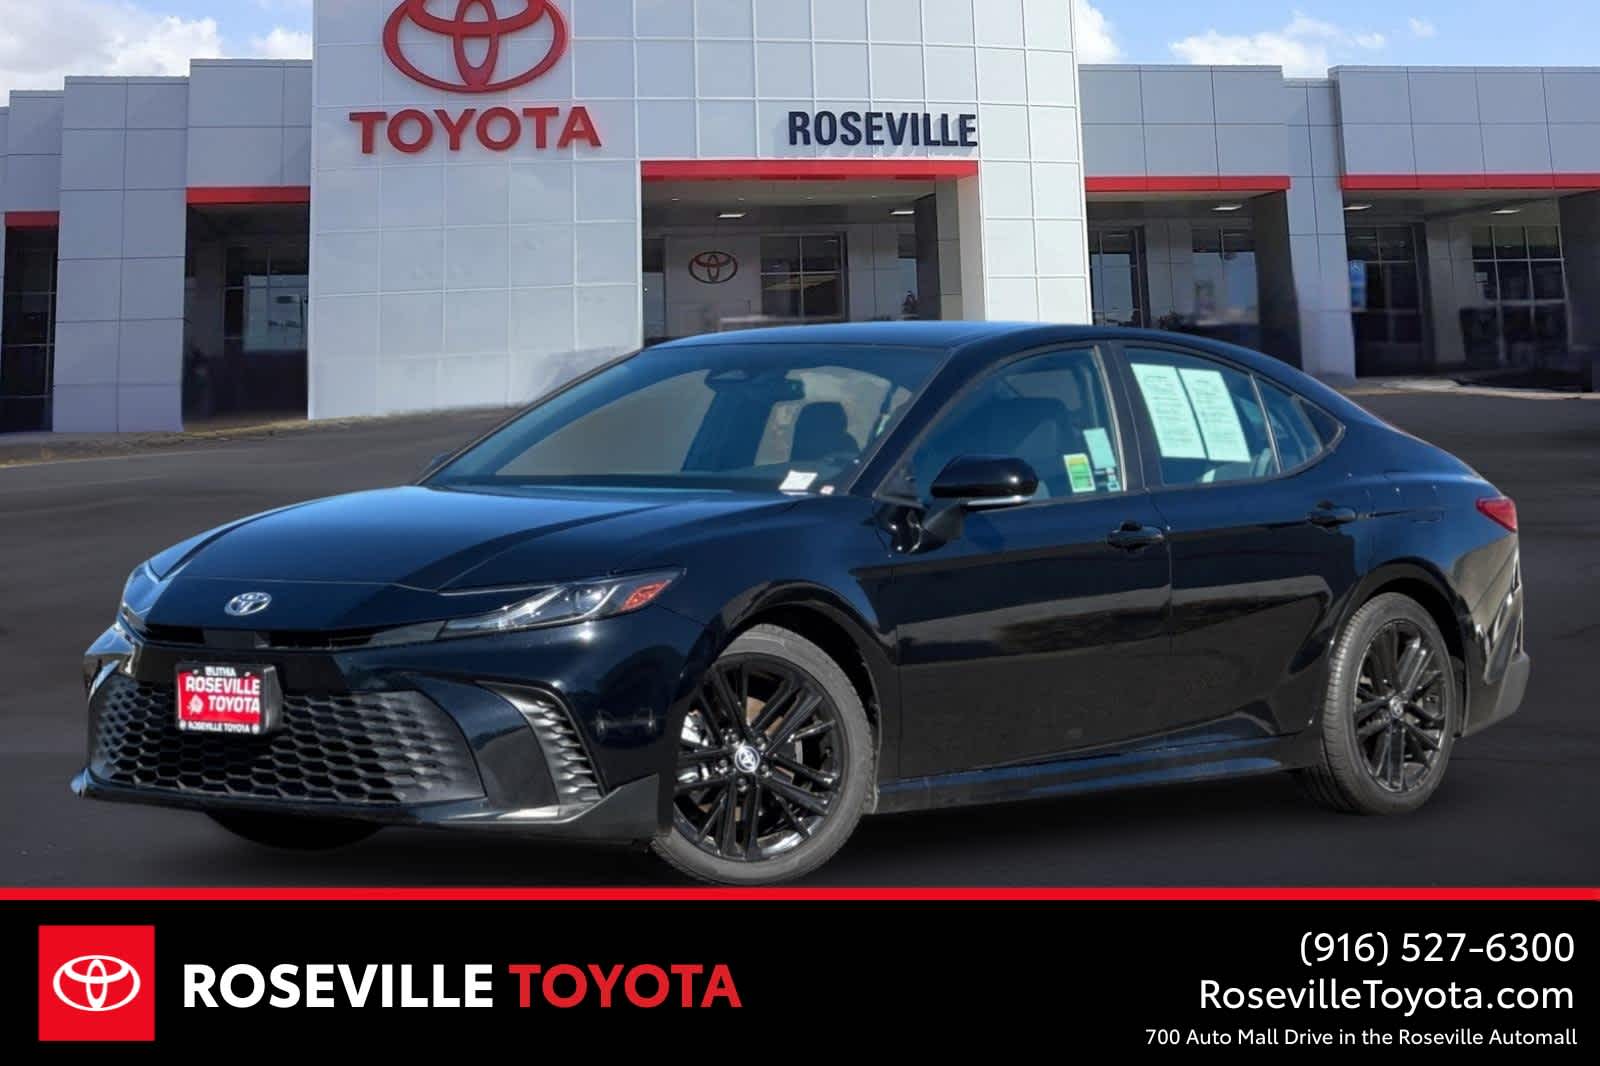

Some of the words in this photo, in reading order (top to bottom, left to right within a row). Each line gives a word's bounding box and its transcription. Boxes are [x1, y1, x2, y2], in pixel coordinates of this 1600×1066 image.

[349, 106, 602, 155] TOYOTA
[787, 110, 978, 147] ROSEVILLE
[185, 676, 261, 695] ROSEVILLE
[207, 694, 260, 714] TOYOTA
